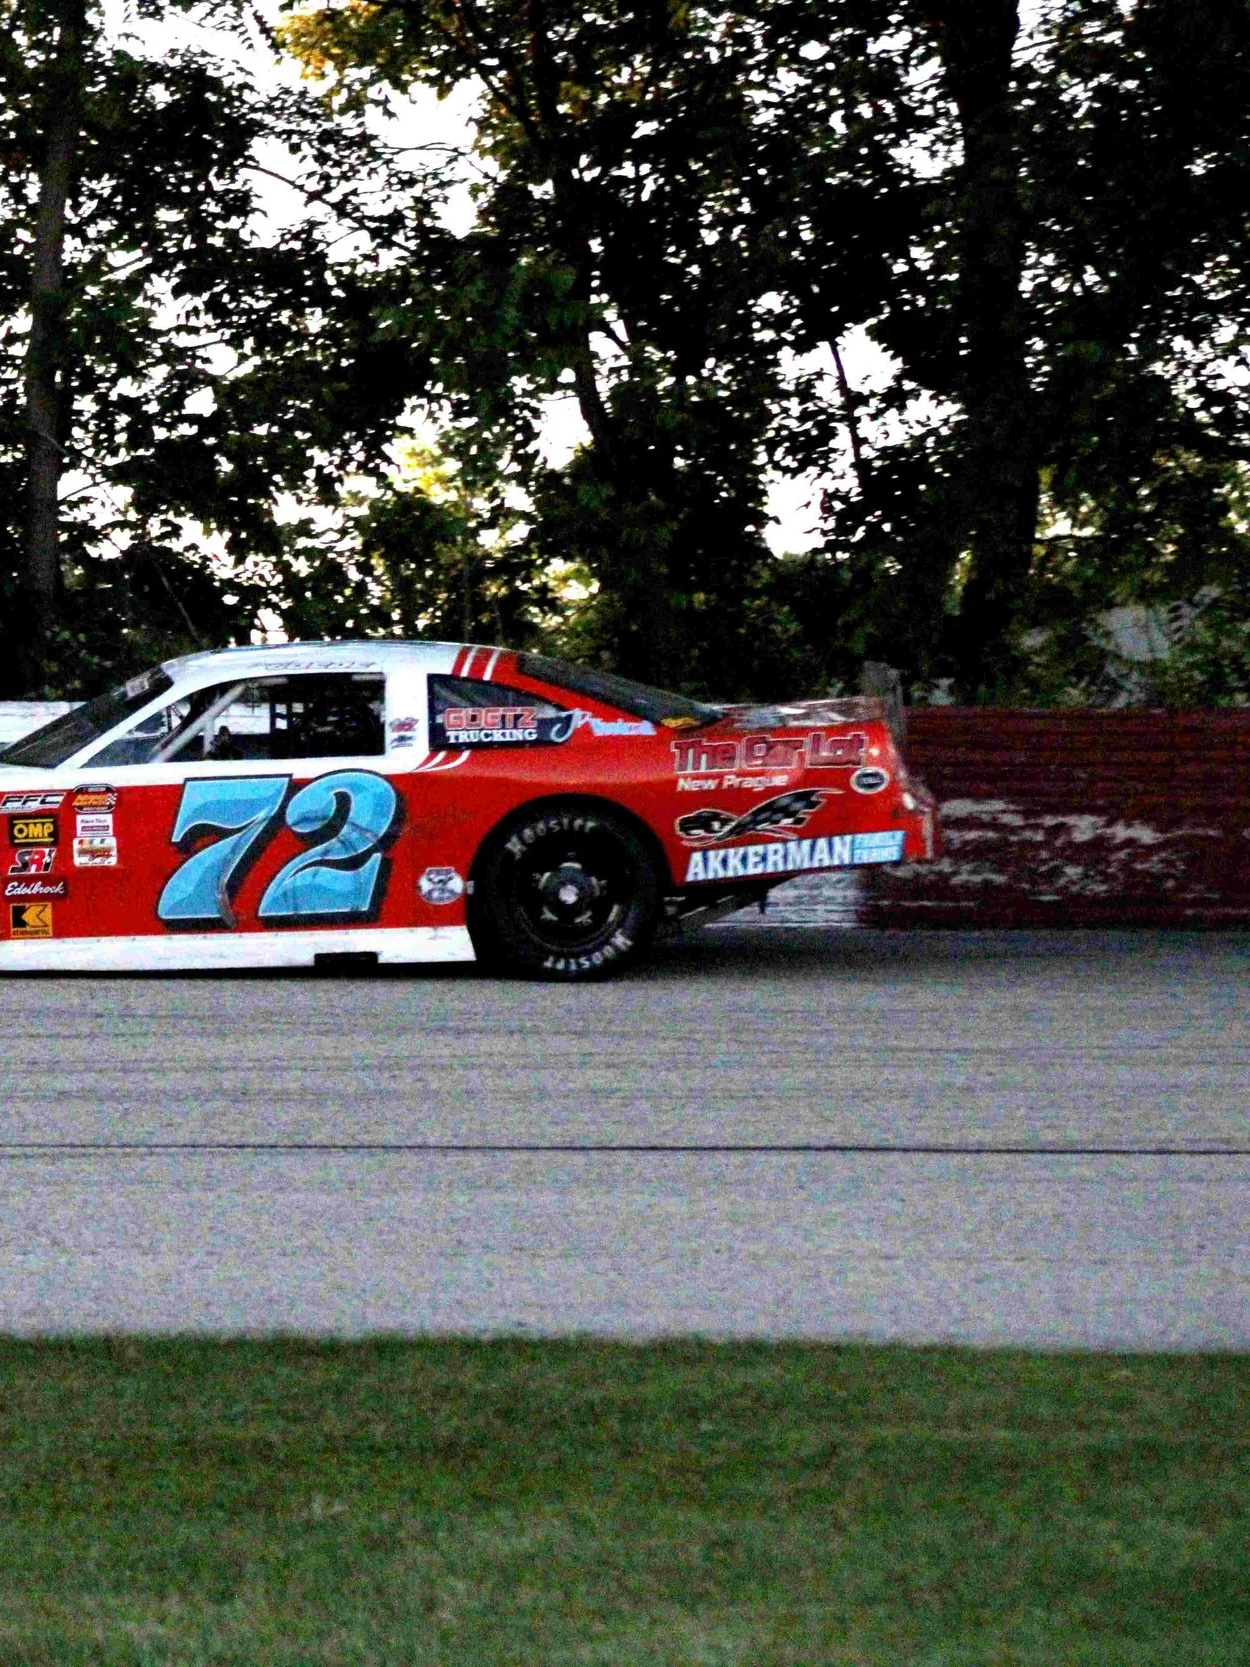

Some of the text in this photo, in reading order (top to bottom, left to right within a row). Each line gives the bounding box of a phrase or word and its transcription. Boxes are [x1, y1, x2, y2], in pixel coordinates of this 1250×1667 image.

[444, 706, 538, 730] GOETZ
[446, 729, 538, 743] TRUCKING
[670, 739, 739, 773] The
[677, 774, 789, 792] New Prague
[13, 822, 54, 838] OMP
[156, 770, 400, 926] 72
[685, 833, 852, 883] AKKERMAN
[5, 880, 66, 896] Edelbrock
